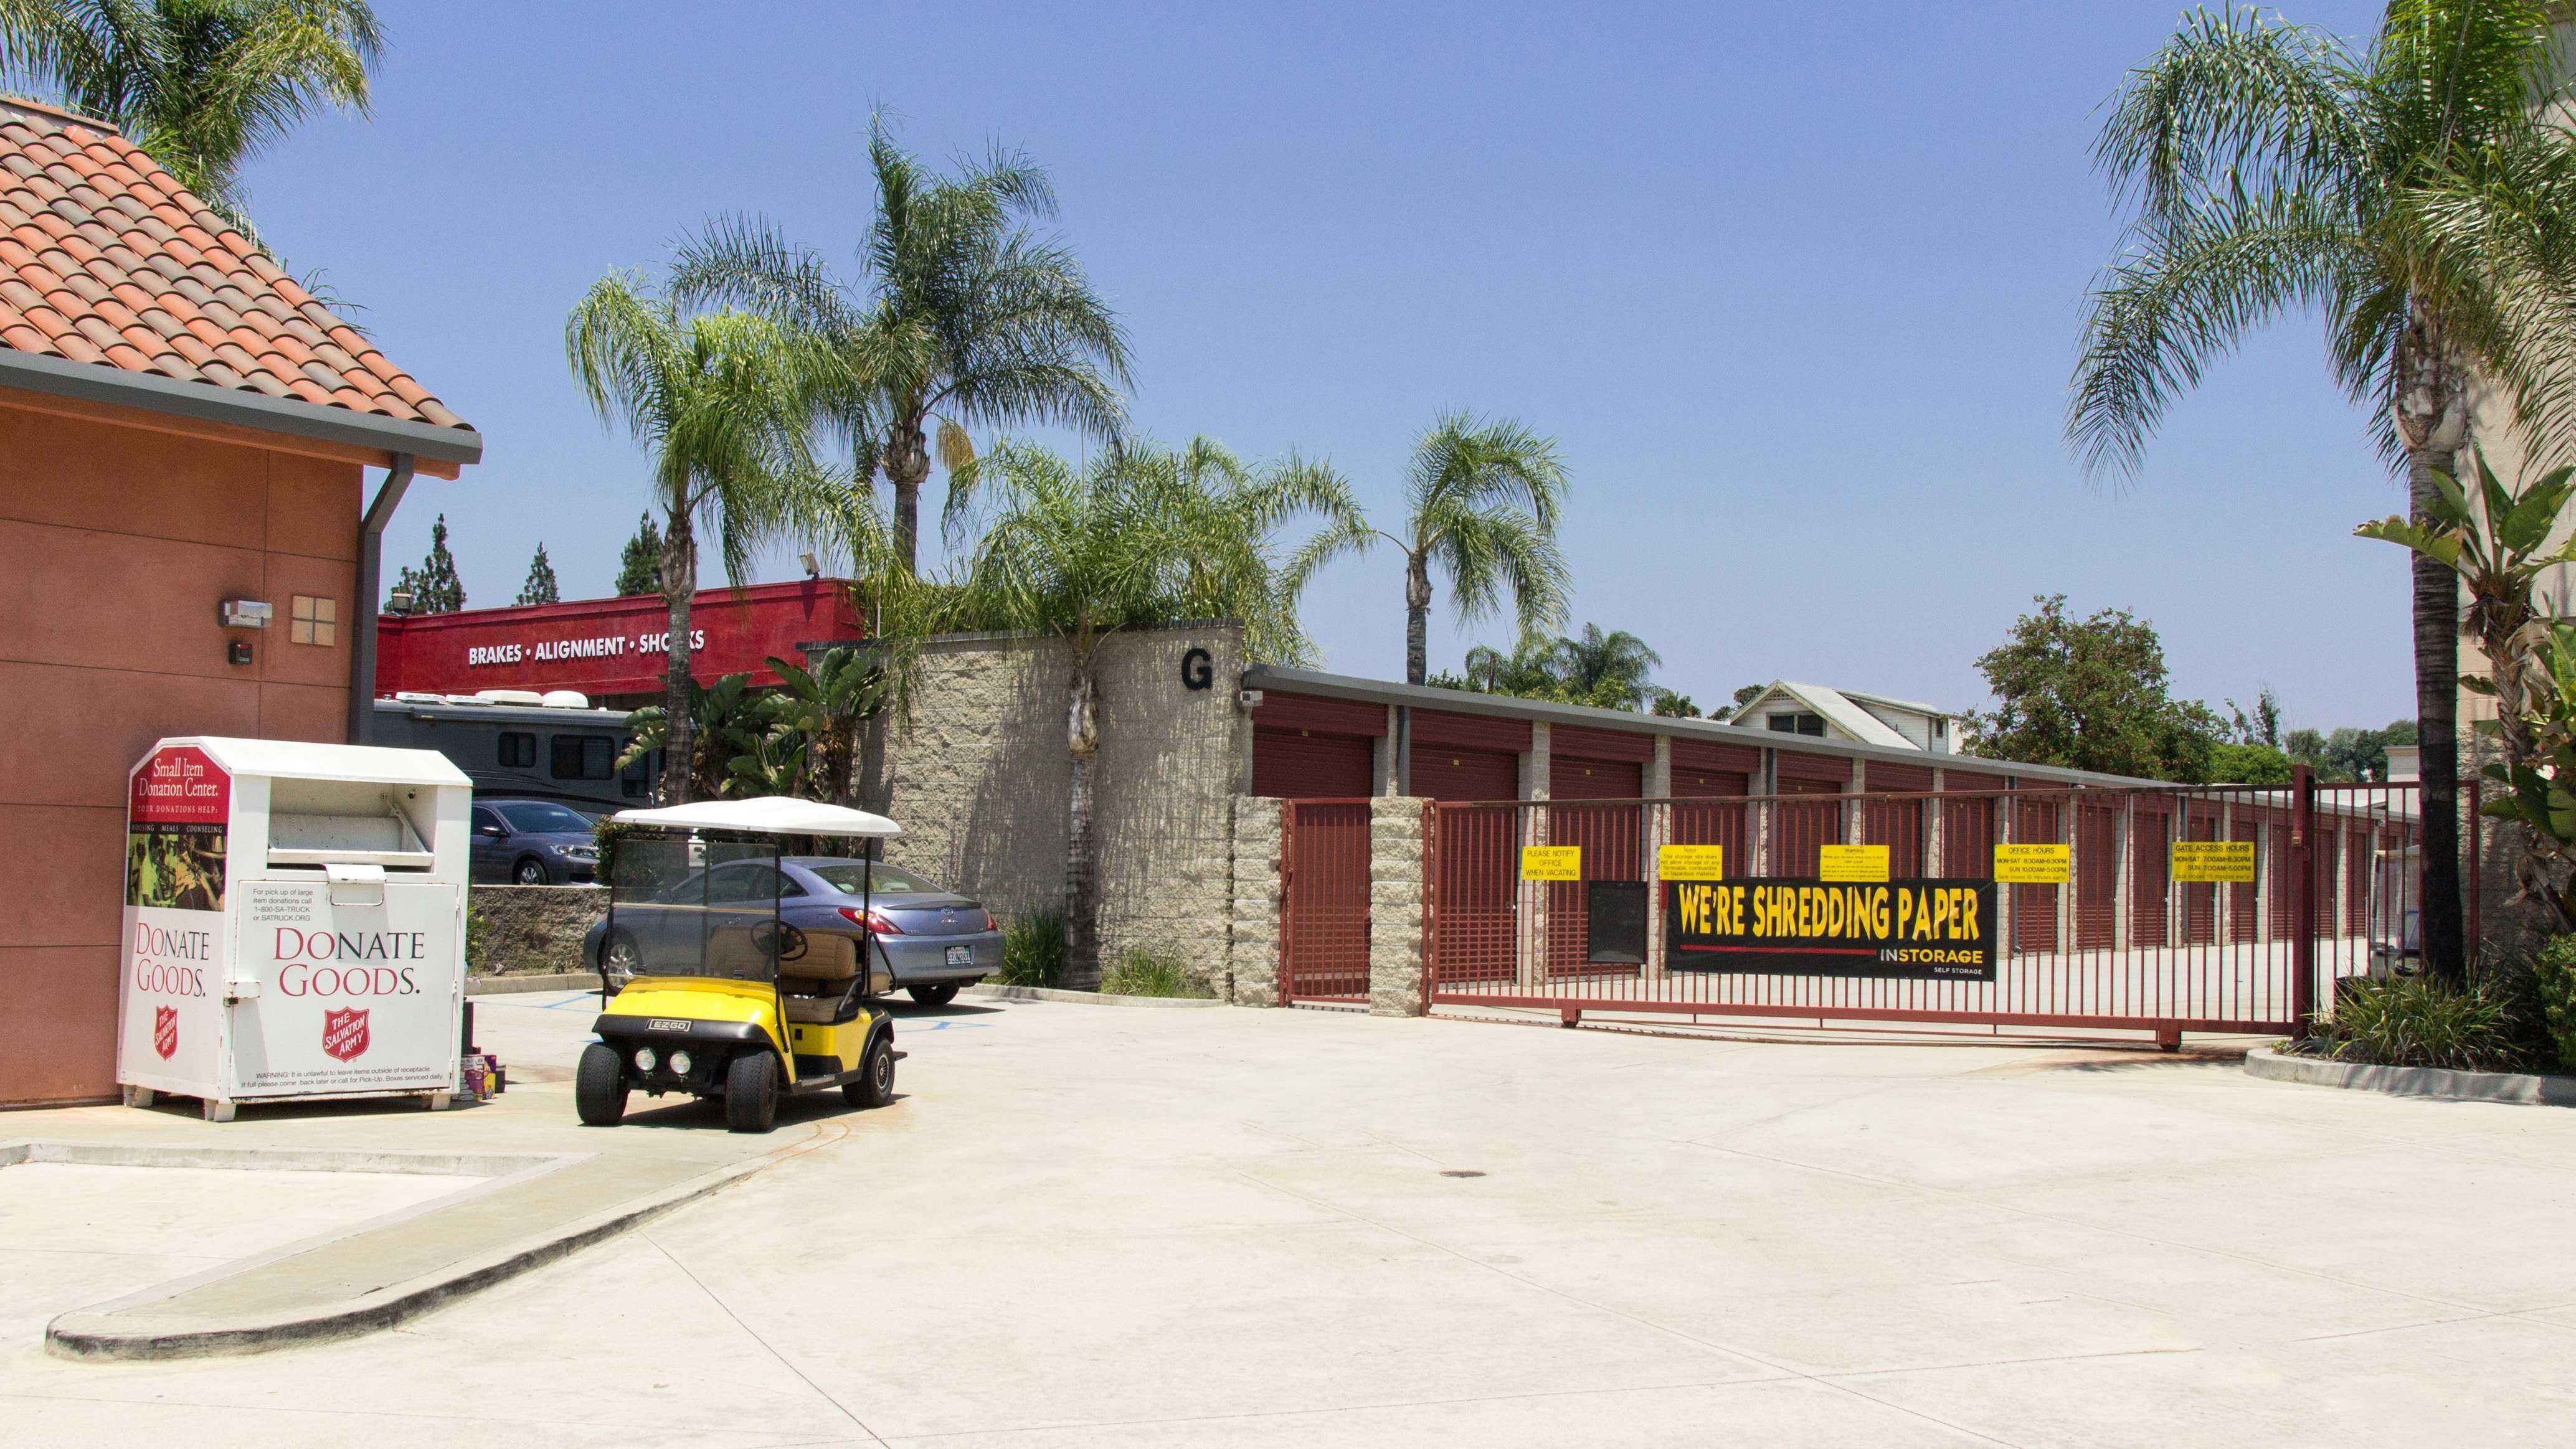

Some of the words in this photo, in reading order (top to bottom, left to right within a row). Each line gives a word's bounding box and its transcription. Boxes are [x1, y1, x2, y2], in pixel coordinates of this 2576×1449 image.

[469, 644, 522, 665] BRAKES
[535, 636, 625, 660] ALIGNMENT
[639, 630, 704, 653] SHOKS
[1181, 648, 1212, 690] G
[153, 757, 181, 776] Small
[183, 758, 203, 776] Item
[140, 778, 182, 796] Donation
[185, 777, 218, 796] Center.
[156, 805, 195, 813] DONATIONS
[187, 825, 222, 833] COUNSELING
[265, 889, 278, 897] pick
[1679, 883, 1745, 935] WE'RE
[1753, 885, 1890, 940] SHREDDING
[1898, 886, 1979, 941] PAPER
[136, 922, 209, 960] DONATE
[273, 927, 425, 960] DONATE
[1880, 948, 1983, 963] INSTORAGE
[138, 959, 206, 997] GOODS.
[280, 964, 420, 996] GOODS.
[325, 1014, 365, 1049] SALVATION
[332, 1012, 350, 1031] THE
[339, 1030, 364, 1056] ARMY
